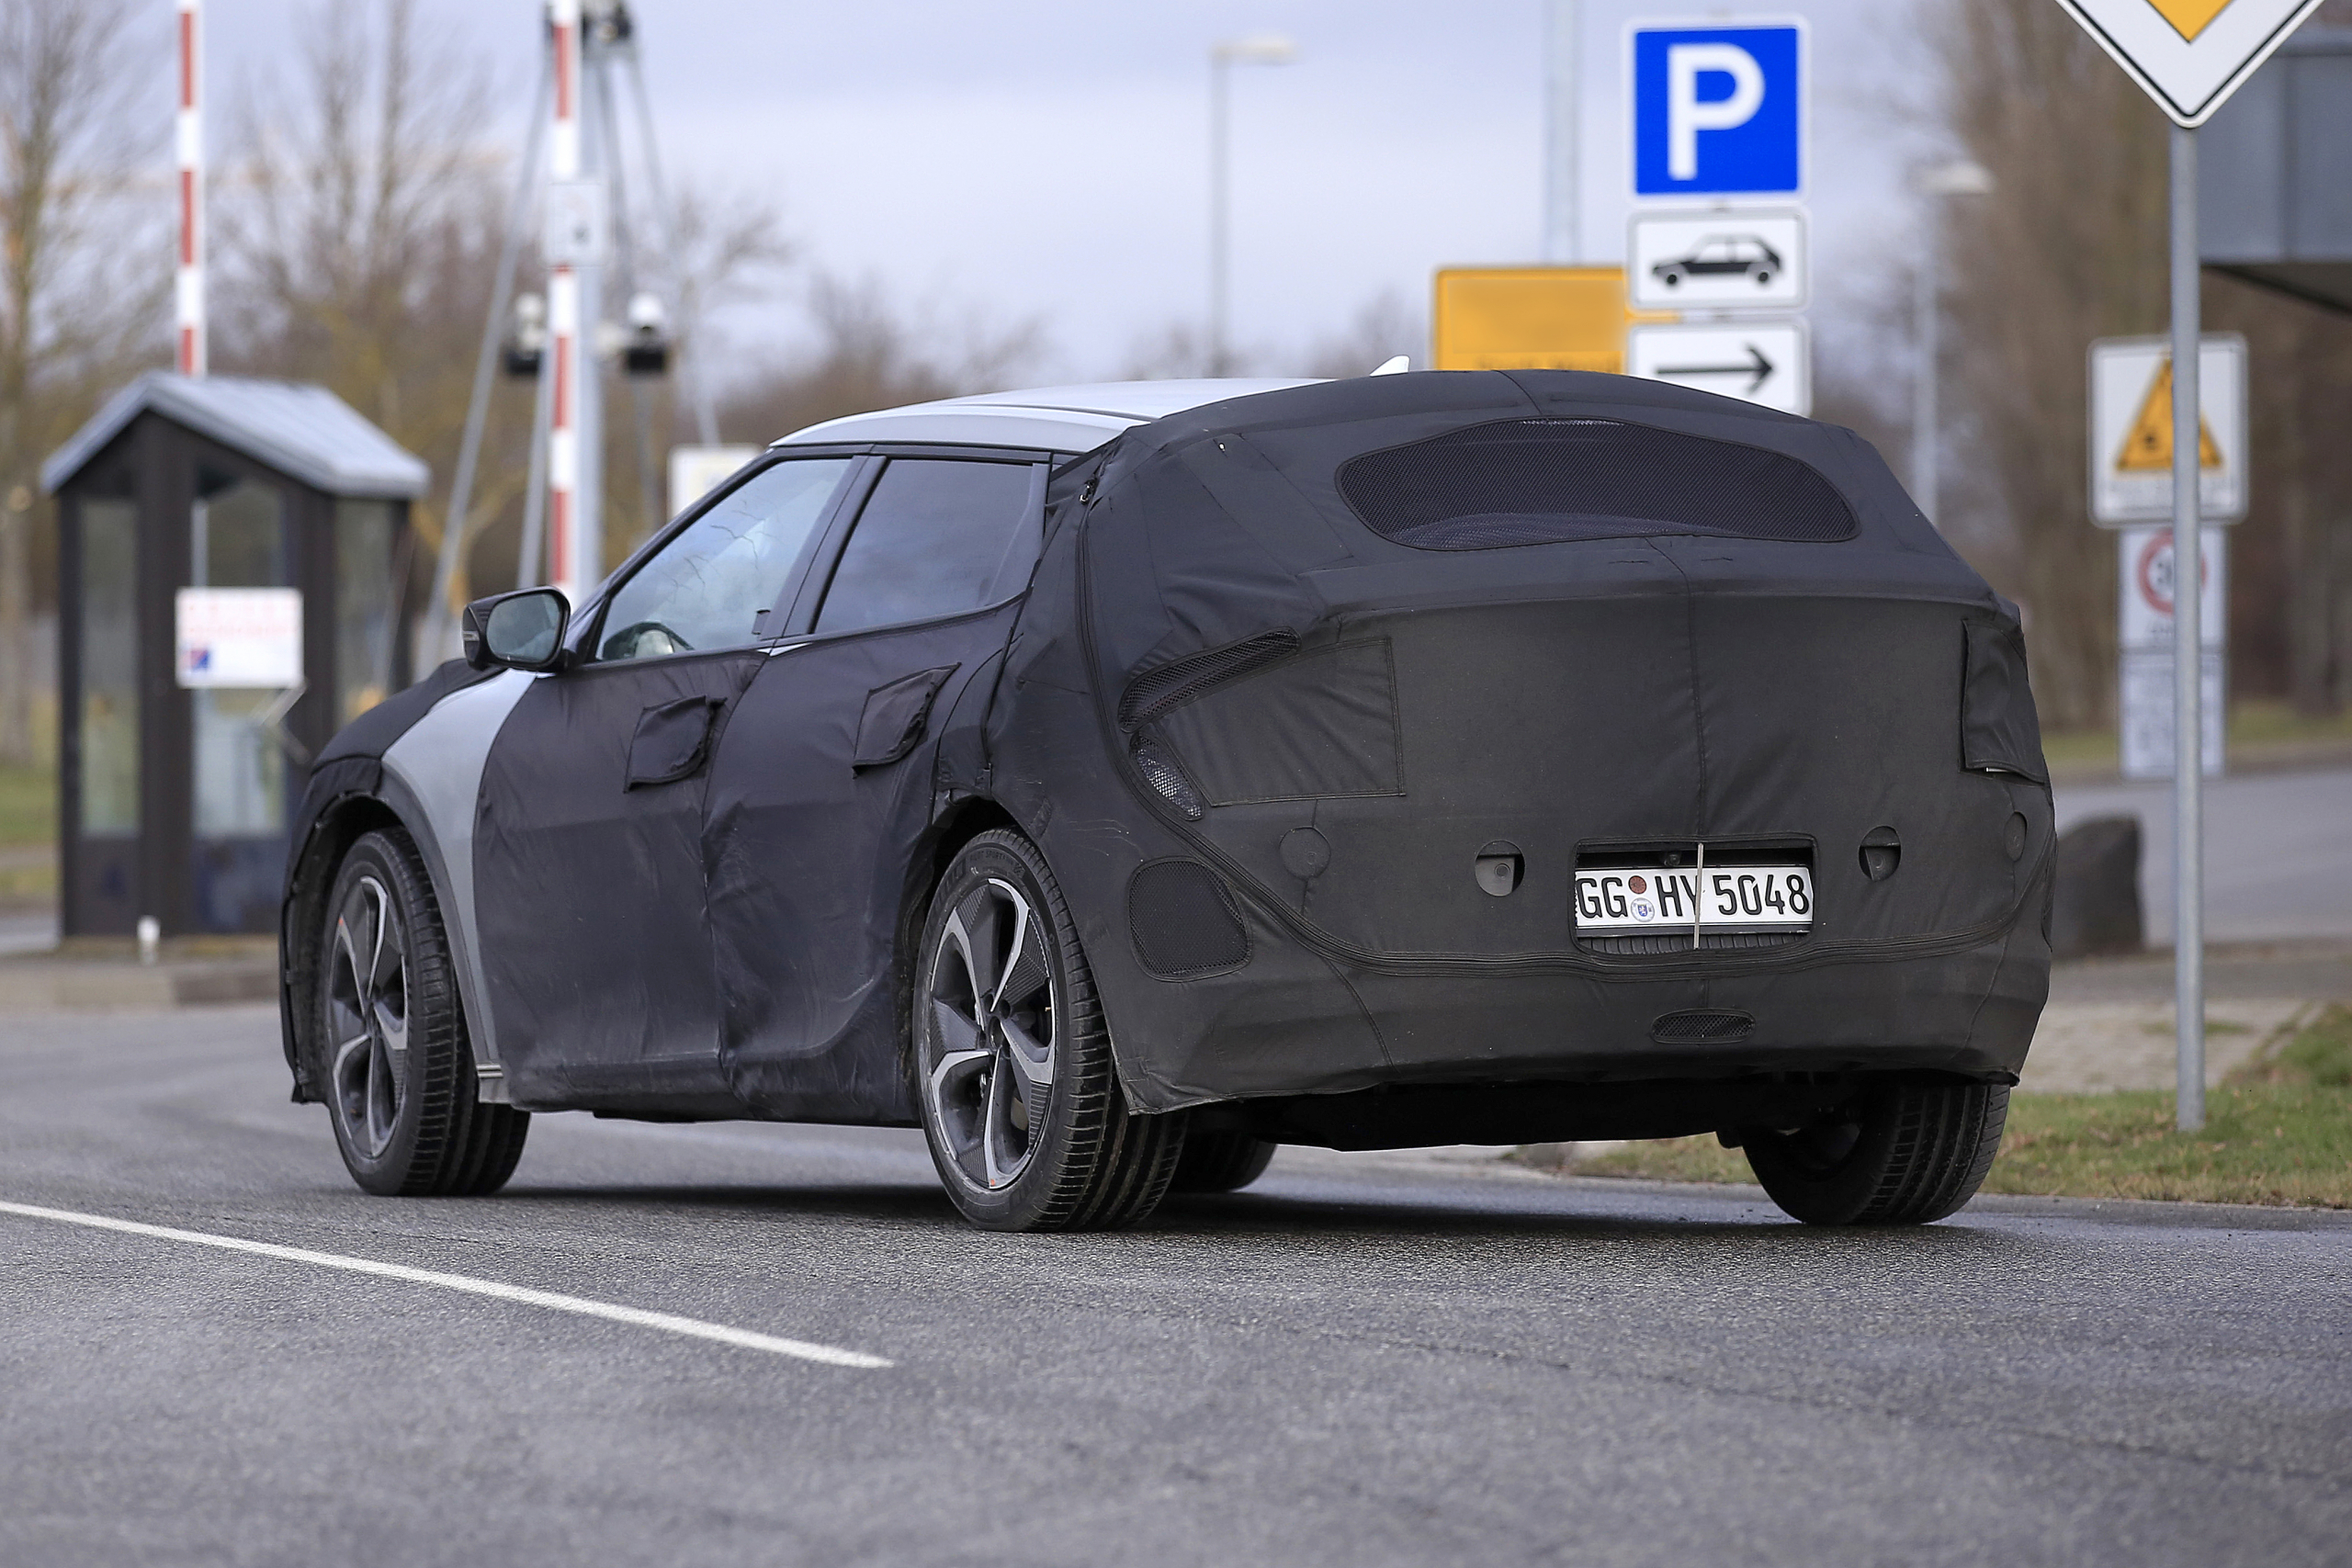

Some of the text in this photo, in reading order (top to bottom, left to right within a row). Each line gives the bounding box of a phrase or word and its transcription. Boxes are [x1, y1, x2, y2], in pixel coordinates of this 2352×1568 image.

[1666, 42, 1766, 181] P
[1576, 874, 1810, 919] GG HY 5048
